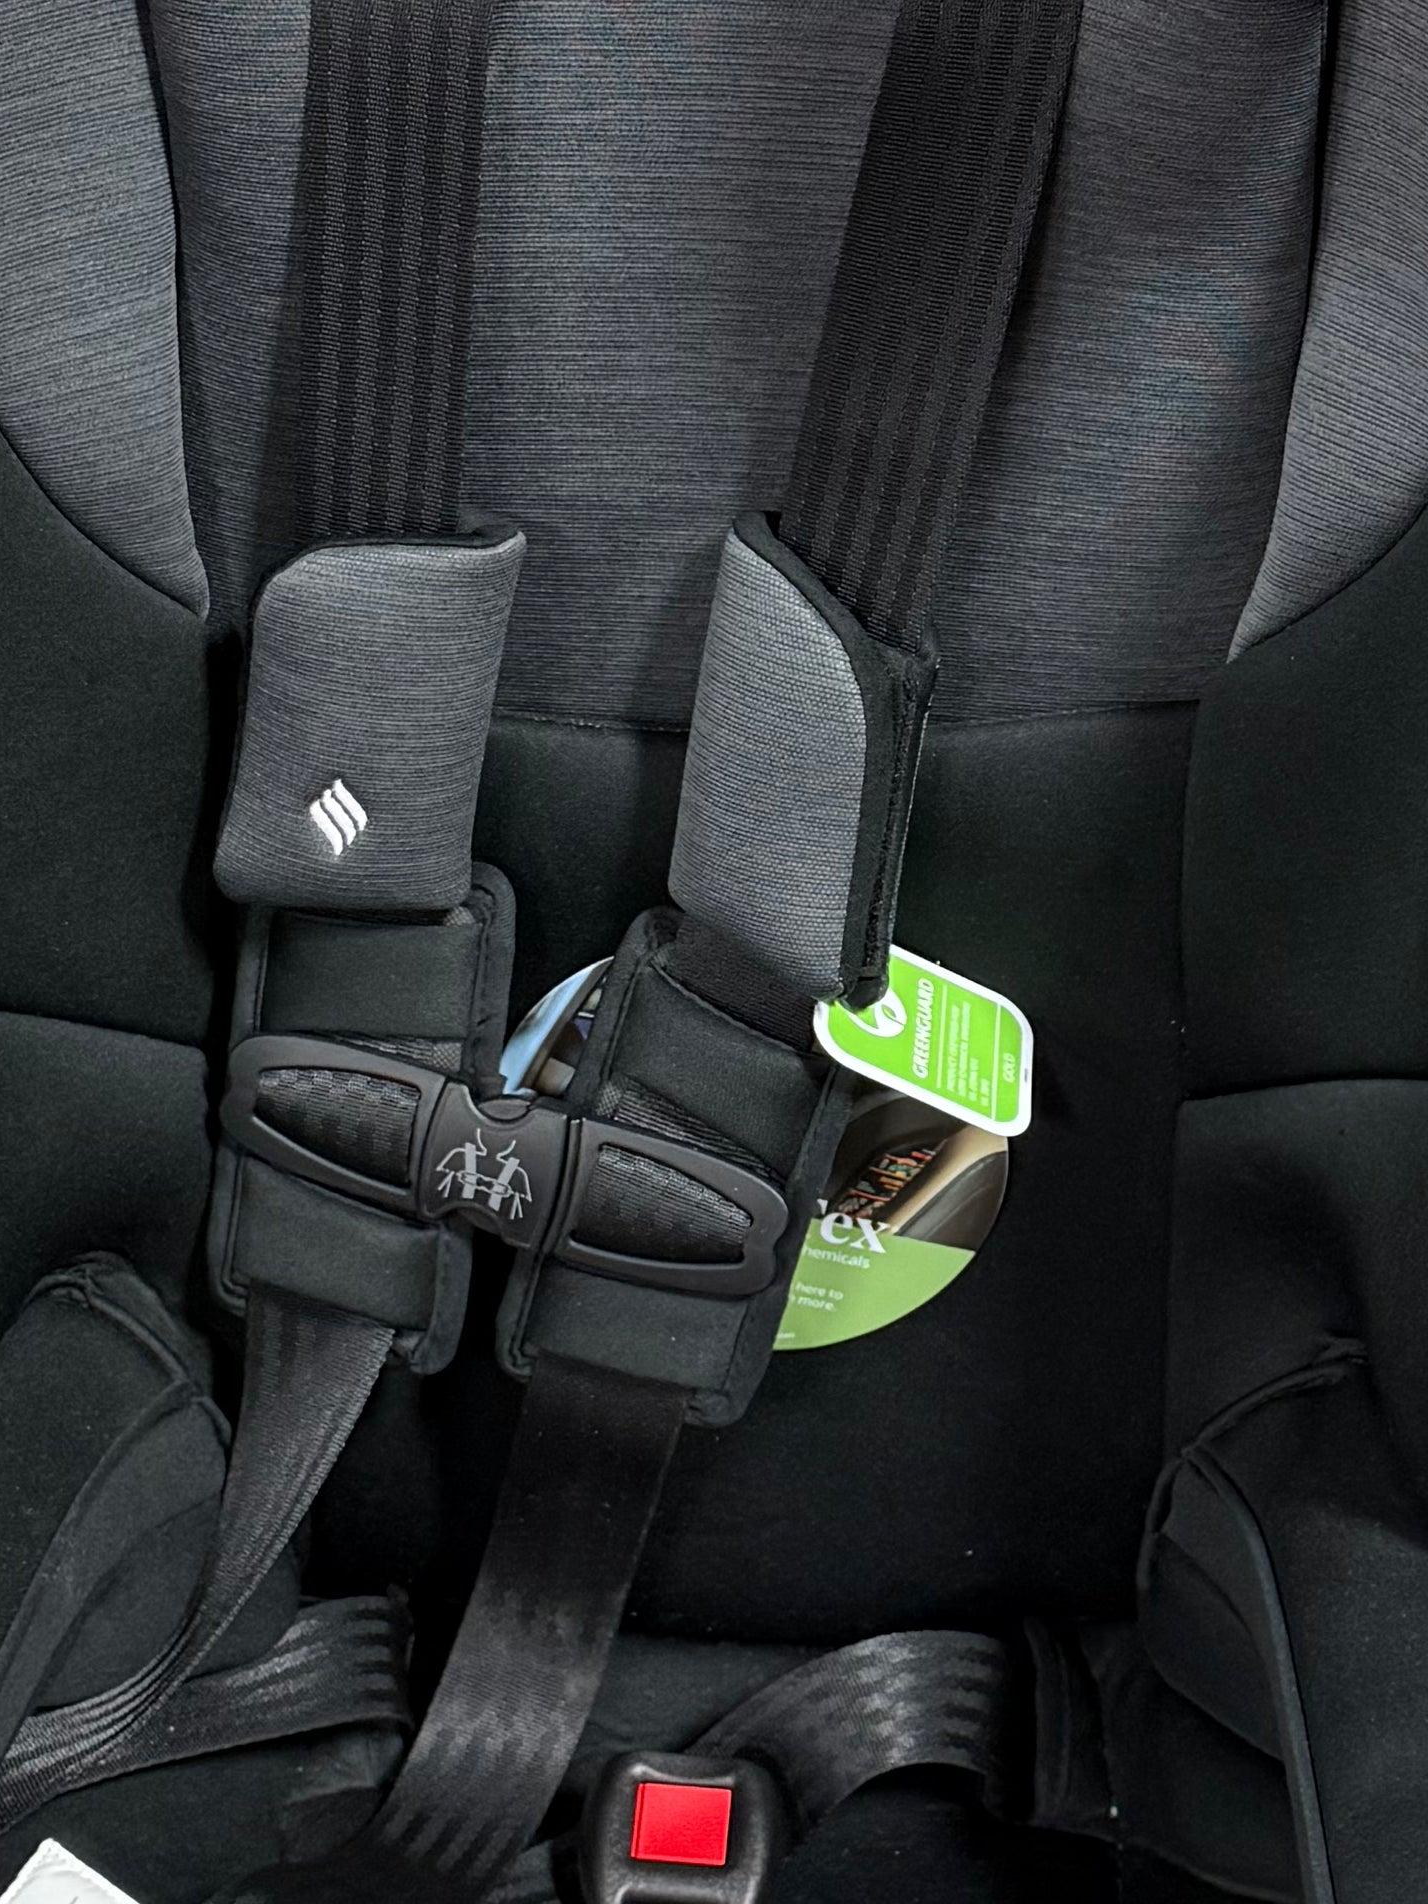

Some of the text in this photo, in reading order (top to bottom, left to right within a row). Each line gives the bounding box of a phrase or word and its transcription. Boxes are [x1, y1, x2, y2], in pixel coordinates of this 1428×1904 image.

[912, 977, 935, 1080] GREENGUARD
[817, 1198, 891, 1254] ex
[795, 1282, 844, 1301] here to
